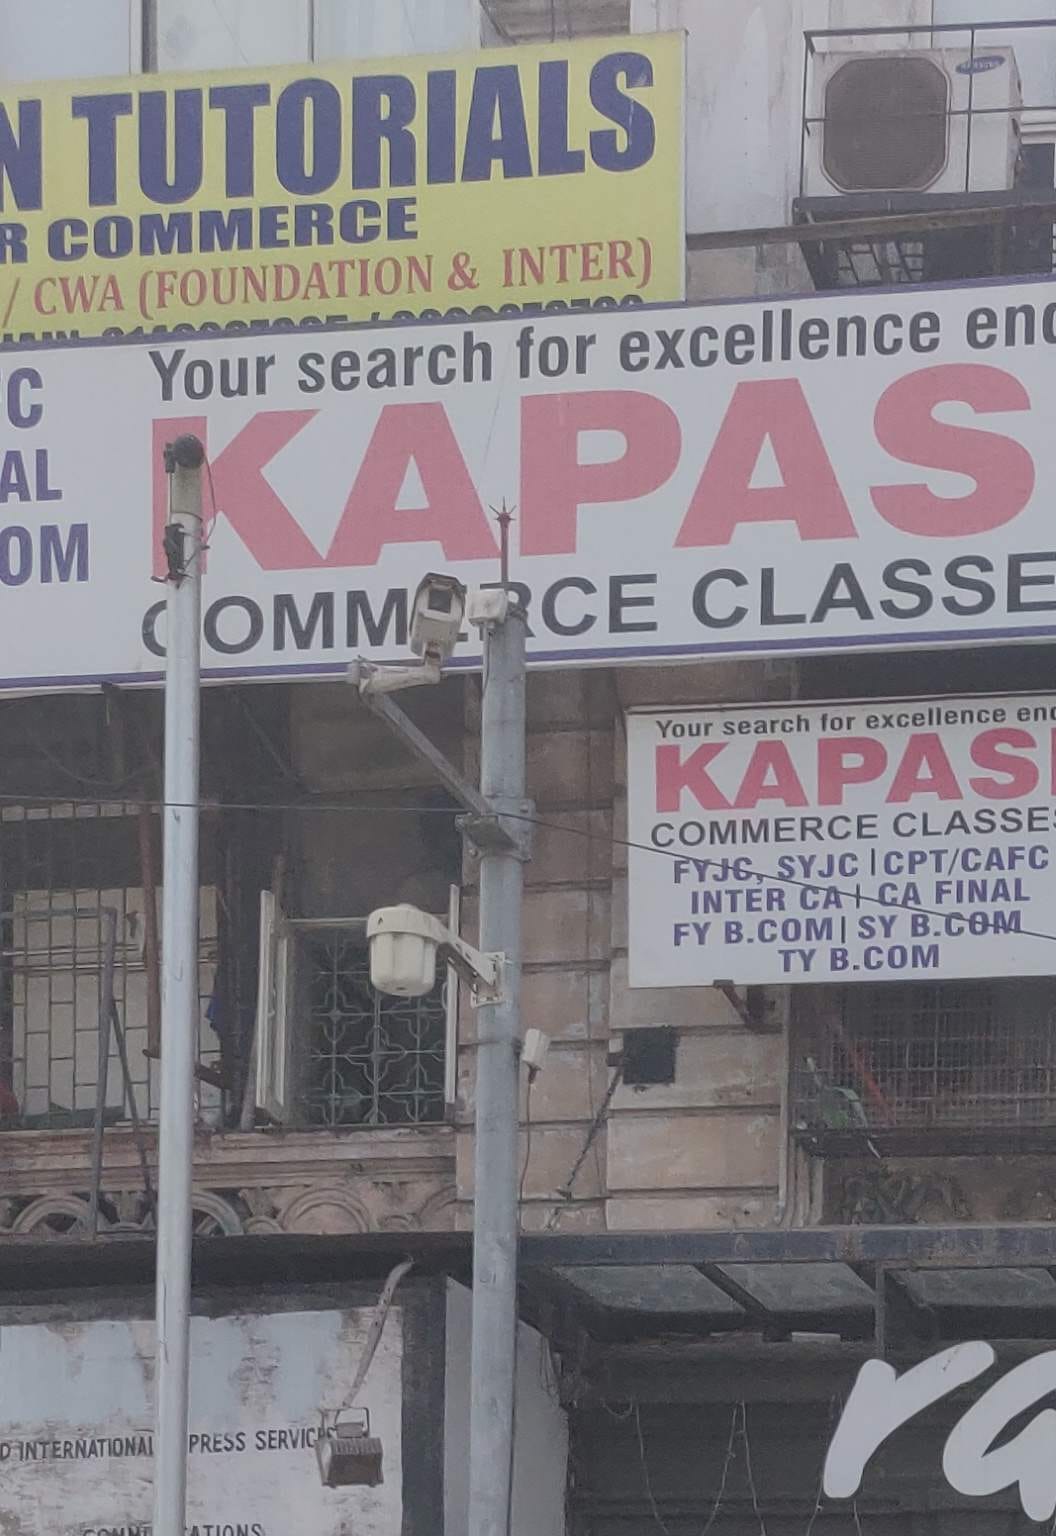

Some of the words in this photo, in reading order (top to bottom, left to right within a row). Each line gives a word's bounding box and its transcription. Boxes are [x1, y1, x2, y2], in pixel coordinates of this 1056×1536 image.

[71, 52, 654, 207] TUTORIALS
[46, 197, 418, 262] COMMERCE
[33, 277, 124, 315] CWA
[138, 254, 434, 319] (FOUNDATION
[446, 252, 479, 291] &
[503, 236, 652, 287] INTER)
[148, 349, 275, 401] Your
[298, 332, 492, 393] search
[517, 325, 596, 378] for
[618, 309, 940, 373] excellence
[0, 368, 43, 429] C
[142, 574, 657, 657] COMMRCE
[656, 719, 715, 738] Your
[723, 715, 809, 735] search
[821, 713, 856, 733] for
[866, 706, 1006, 730] excellence
[651, 814, 878, 847] COMMERCE
[674, 859, 764, 885] FYJC,
[778, 852, 858, 880] SYJC
[884, 845, 1049, 877] CPT/CAFC
[691, 889, 786, 914] INTER
[800, 886, 843, 910] CA
[878, 882, 921, 907] CA
[936, 878, 1030, 904] FINAL
[674, 923, 710, 946] FY
[858, 914, 897, 939] SY
[911, 910, 1021, 936] B.COM
[778, 949, 815, 973] TY
[830, 944, 939, 971] B.COM
